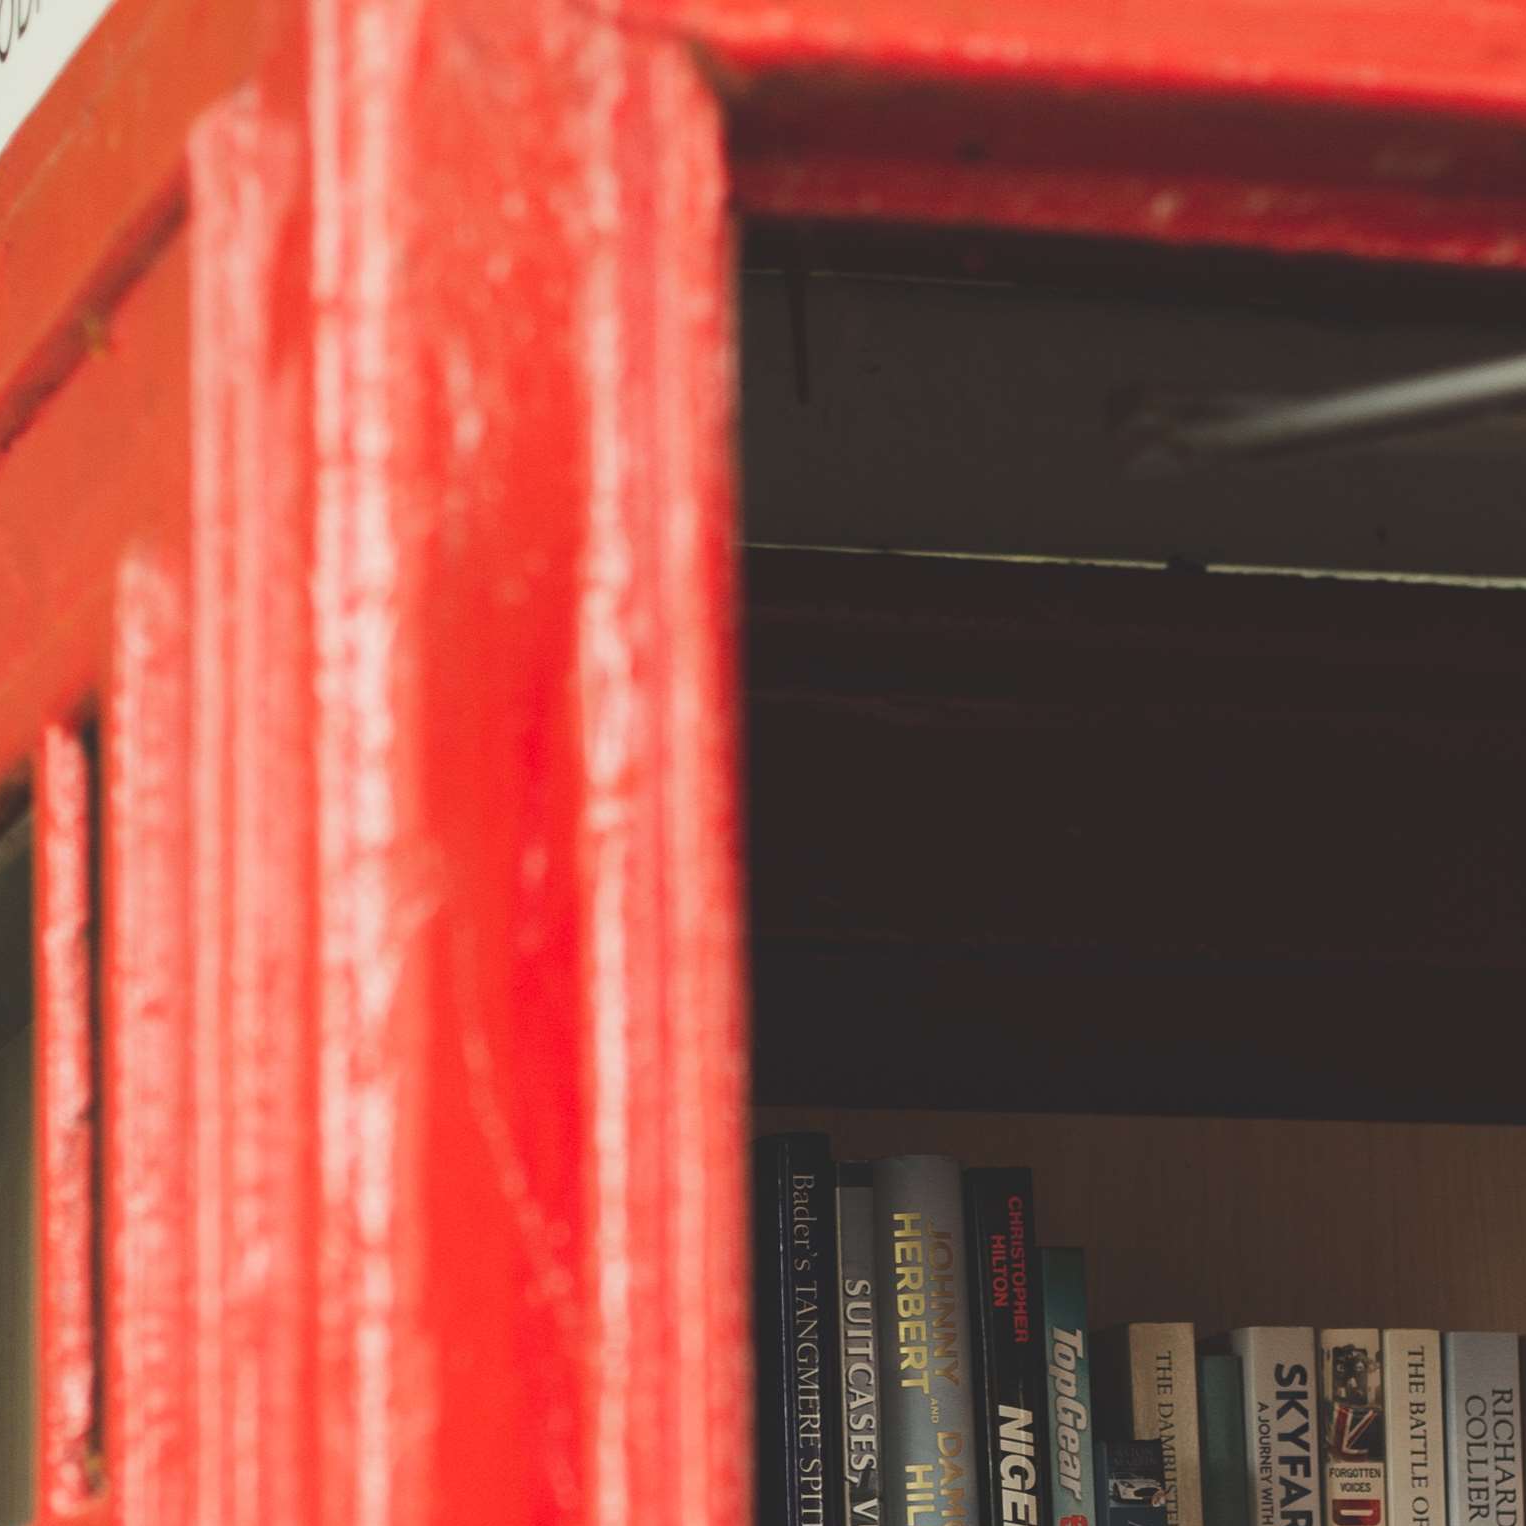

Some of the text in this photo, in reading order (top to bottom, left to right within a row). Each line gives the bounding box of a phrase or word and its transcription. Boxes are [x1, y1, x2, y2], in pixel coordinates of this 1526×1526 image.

[792, 1174, 818, 1271] Bader's
[892, 1212, 930, 1395] HERBERT
[928, 1219, 961, 1387] JOHNNY
[990, 1234, 1010, 1308] HILTON
[1008, 1196, 1030, 1343] CHRISTOPHER
[795, 1281, 822, 1448] TANGMERE
[842, 1279, 879, 1487] SUITCASES,
[1156, 1350, 1174, 1395] THE
[1407, 1345, 1425, 1394] THE
[929, 1398, 941, 1424] AND
[1257, 1401, 1270, 1414] A
[1258, 1416, 1274, 1486] JOURNEY
[1329, 1467, 1382, 1479] FORGOTTEN
[1408, 1401, 1428, 1489] BATTLE
[1465, 1395, 1490, 1522] COLLIER
[1260, 1488, 1275, 1522] WITH
[1340, 1483, 1372, 1493] VOICES
